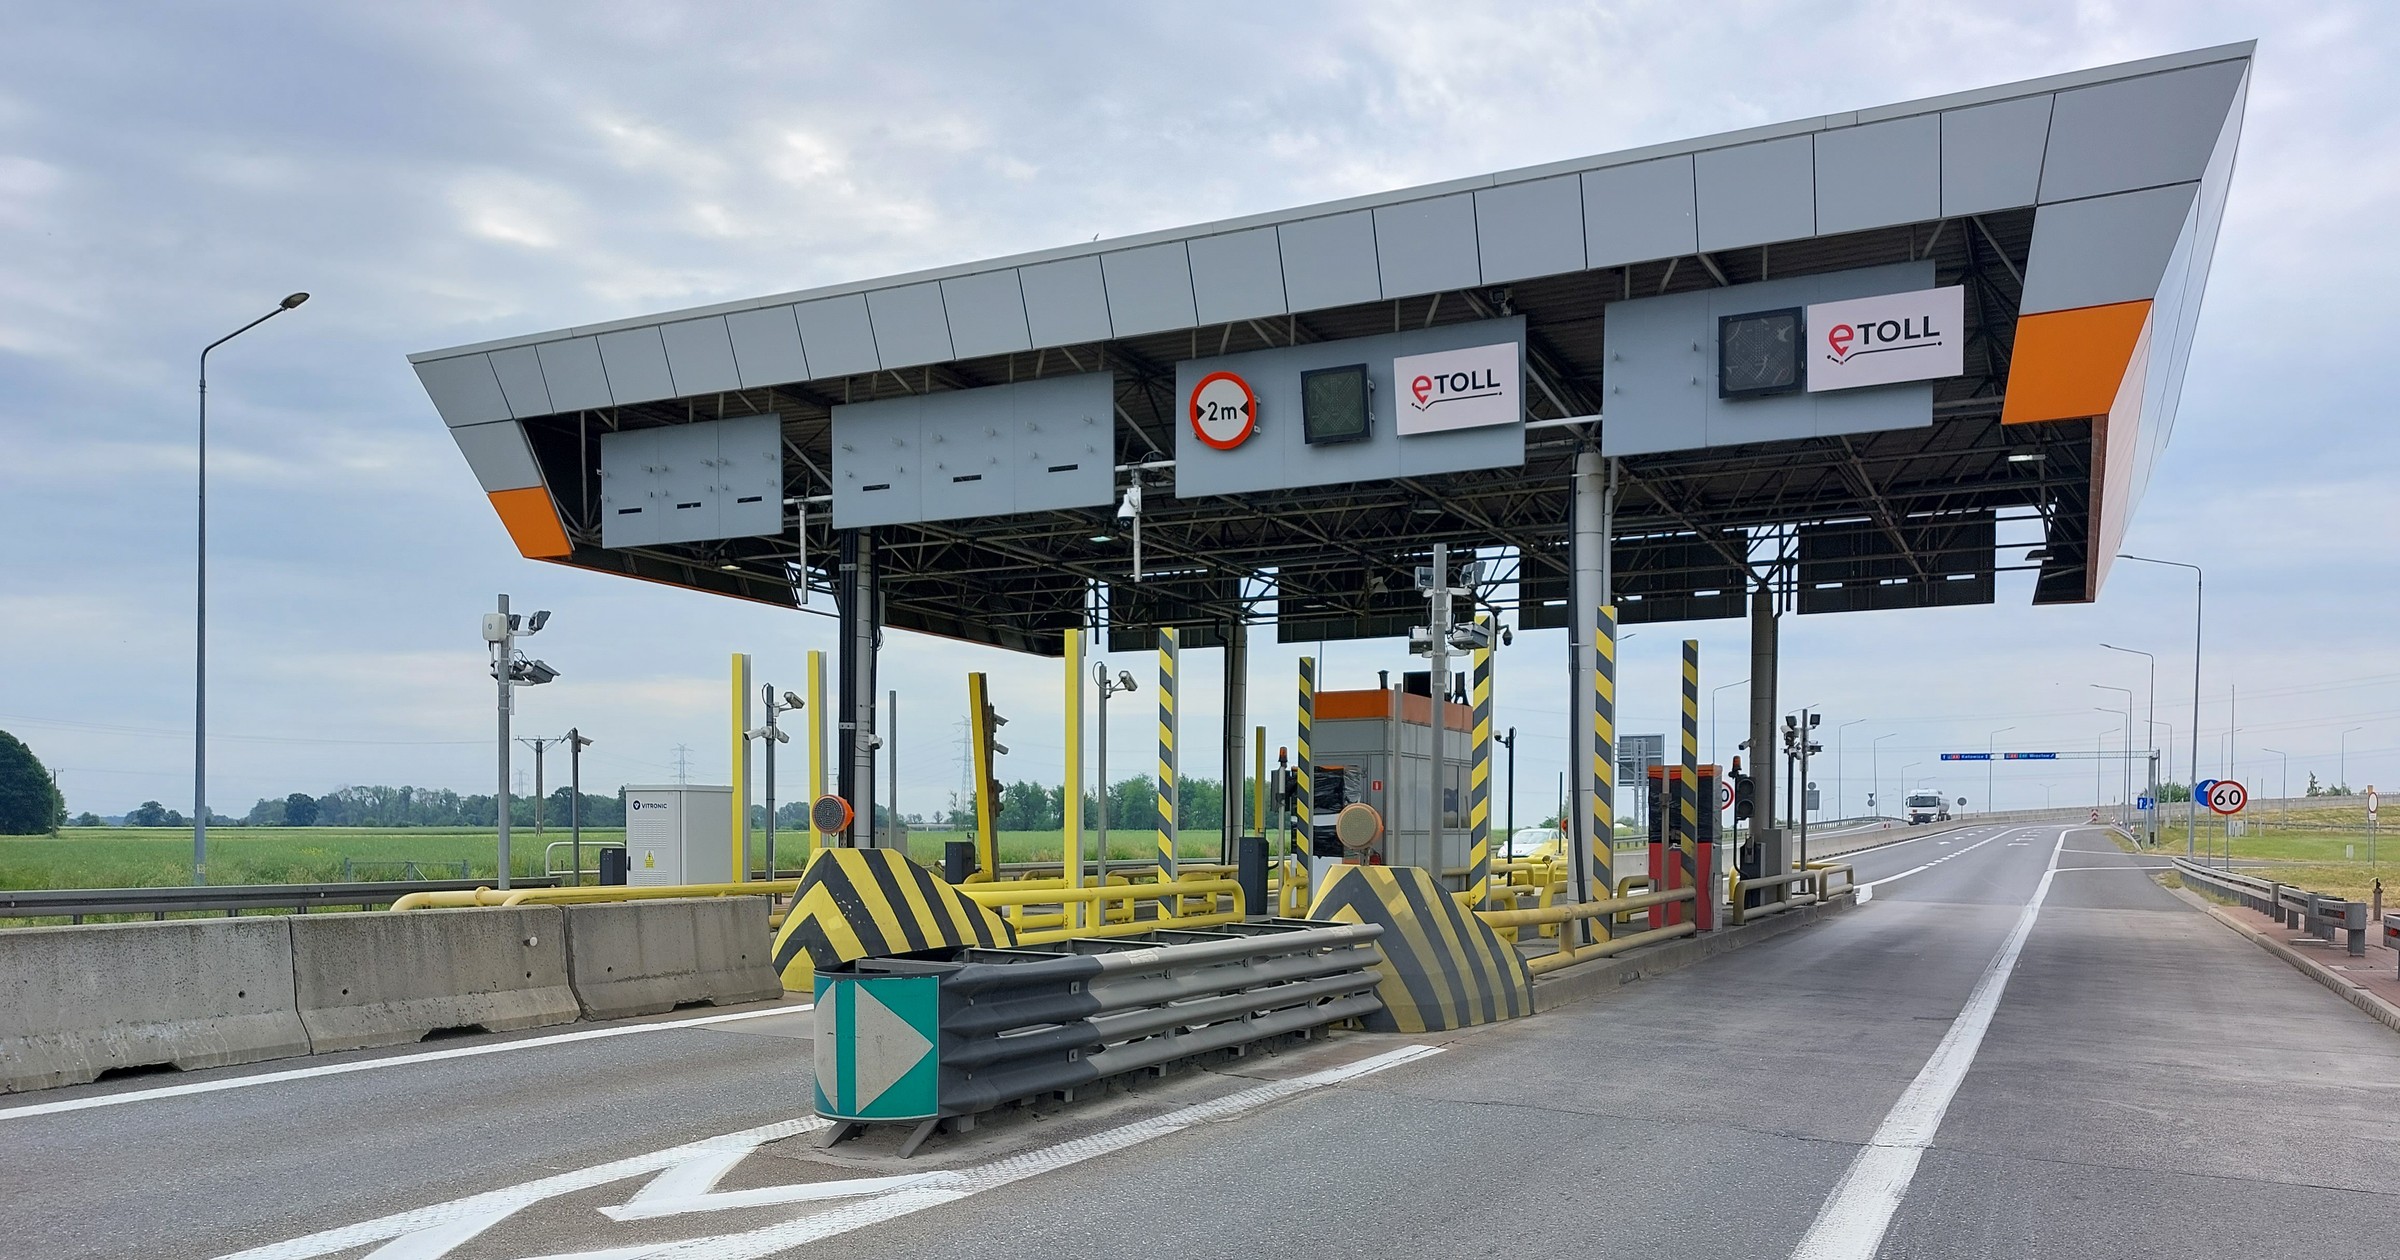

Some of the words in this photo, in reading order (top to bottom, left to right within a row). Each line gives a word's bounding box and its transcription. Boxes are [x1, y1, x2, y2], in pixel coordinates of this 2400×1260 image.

[1828, 315, 1941, 358] eTOLL
[1411, 368, 1501, 405] eTOLL
[1721, 788, 1730, 802] 0
[2213, 789, 2241, 805] 60
